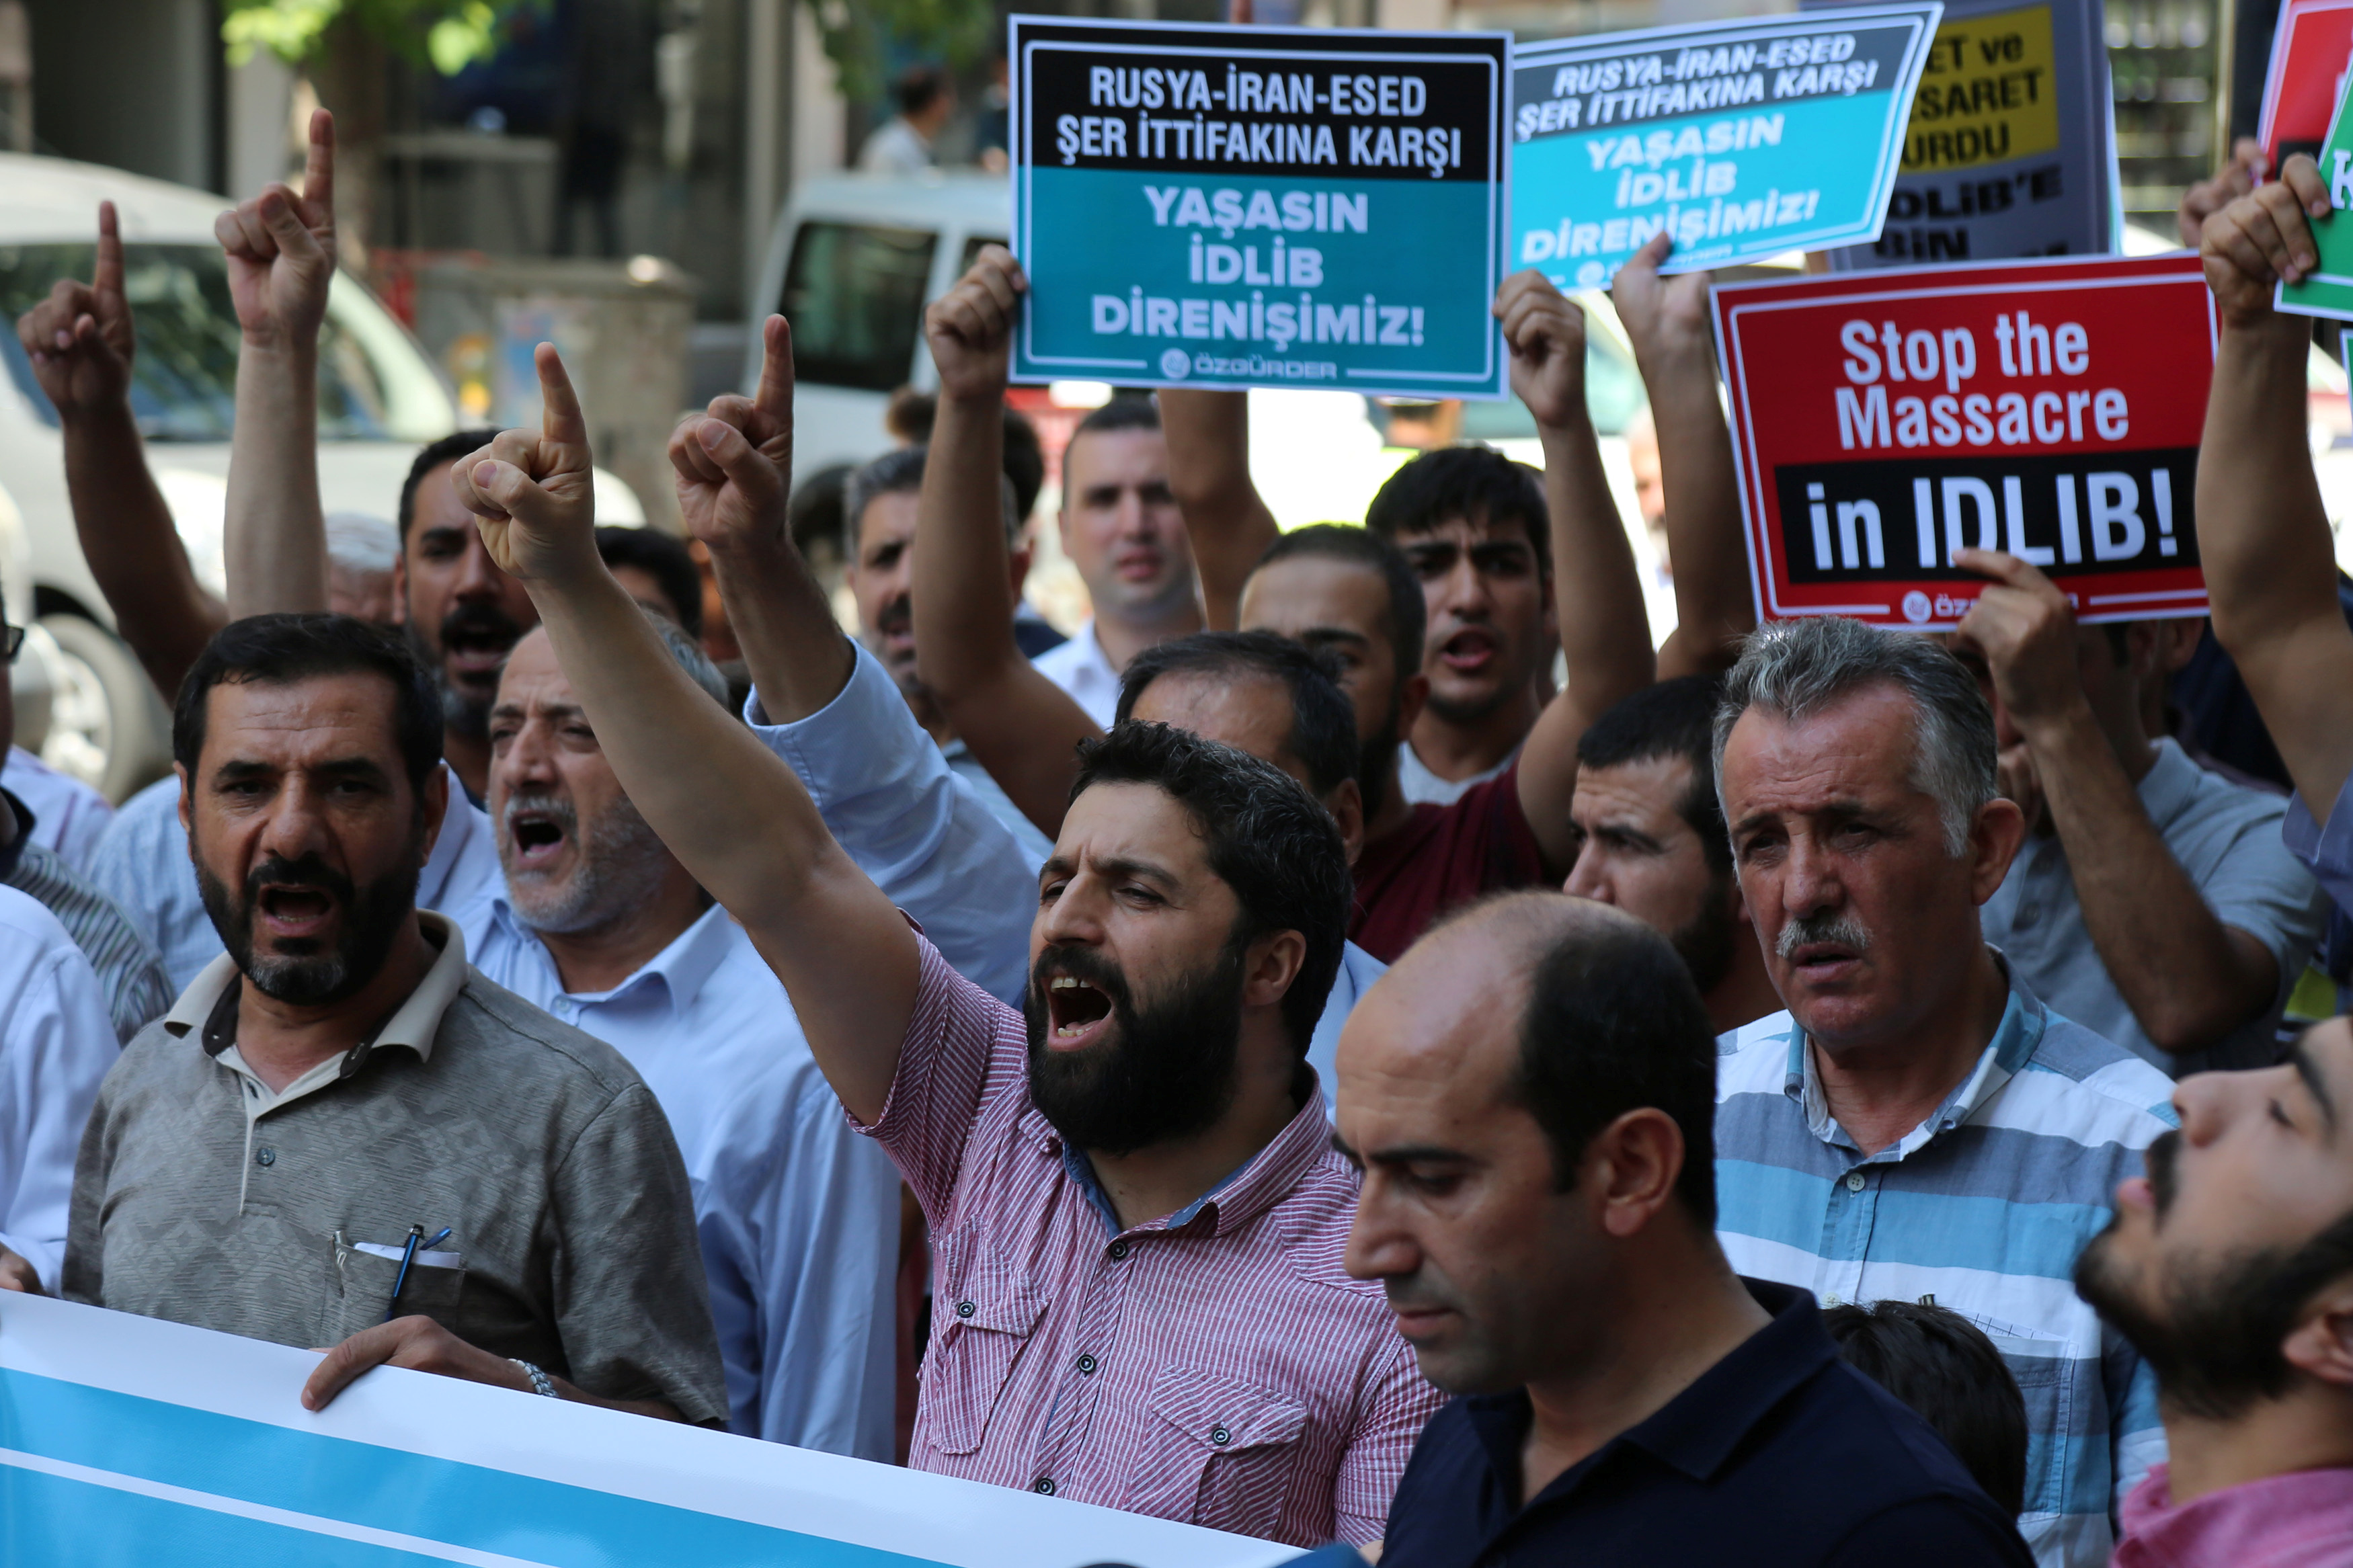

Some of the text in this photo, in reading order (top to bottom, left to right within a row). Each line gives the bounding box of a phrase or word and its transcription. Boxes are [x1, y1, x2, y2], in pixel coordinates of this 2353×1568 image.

[1090, 63, 1427, 117] RUSYA-İRAN-ESED
[1552, 34, 1856, 97] RUSYA-İRAN-ESED
[1909, 66, 2044, 124] SARET
[1515, 59, 1879, 142] ŞER İTTİFAKINA KARŞI
[1056, 110, 1462, 178] ŞER İTTİFAKINA KARŞI
[1587, 113, 1785, 171] YAŞASIN
[1145, 185, 1369, 239] YAŞASIN
[1616, 159, 1737, 209] İDLİB
[1521, 188, 1820, 263] DİRENİŞİMİZ!
[1189, 233, 1324, 288] İDLİB
[1092, 286, 1425, 352] DİRENİŞİMİZ!
[1194, 352, 1338, 380] ÖZGÜRDER
[1839, 310, 2089, 394] Stop the
[1835, 384, 2129, 450] Massacre
[1808, 468, 2178, 571] in IDLIB!
